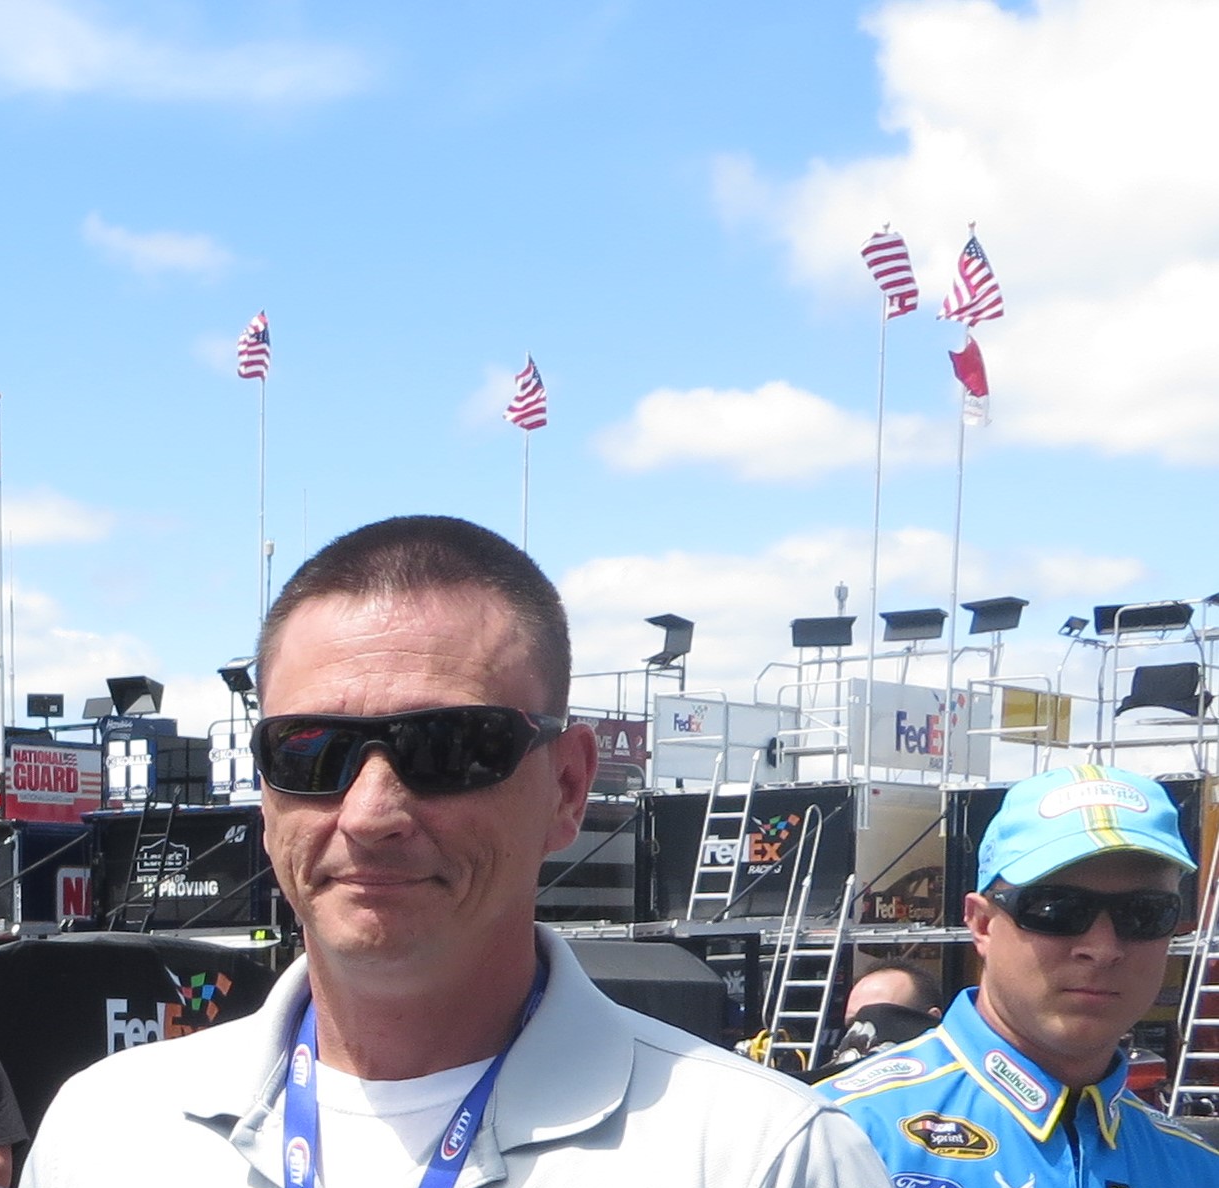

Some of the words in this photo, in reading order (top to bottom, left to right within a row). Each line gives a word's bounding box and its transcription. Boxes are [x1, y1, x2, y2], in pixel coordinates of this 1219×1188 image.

[673, 713, 703, 733] FedEx
[13, 750, 65, 766] NATIONAL
[13, 764, 78, 793] GUARD
[876, 896, 908, 919] FedEx
[448, 1107, 473, 1149] PETTY
[931, 1131, 964, 1146] Sprint
[291, 1147, 307, 1188] PETTY
